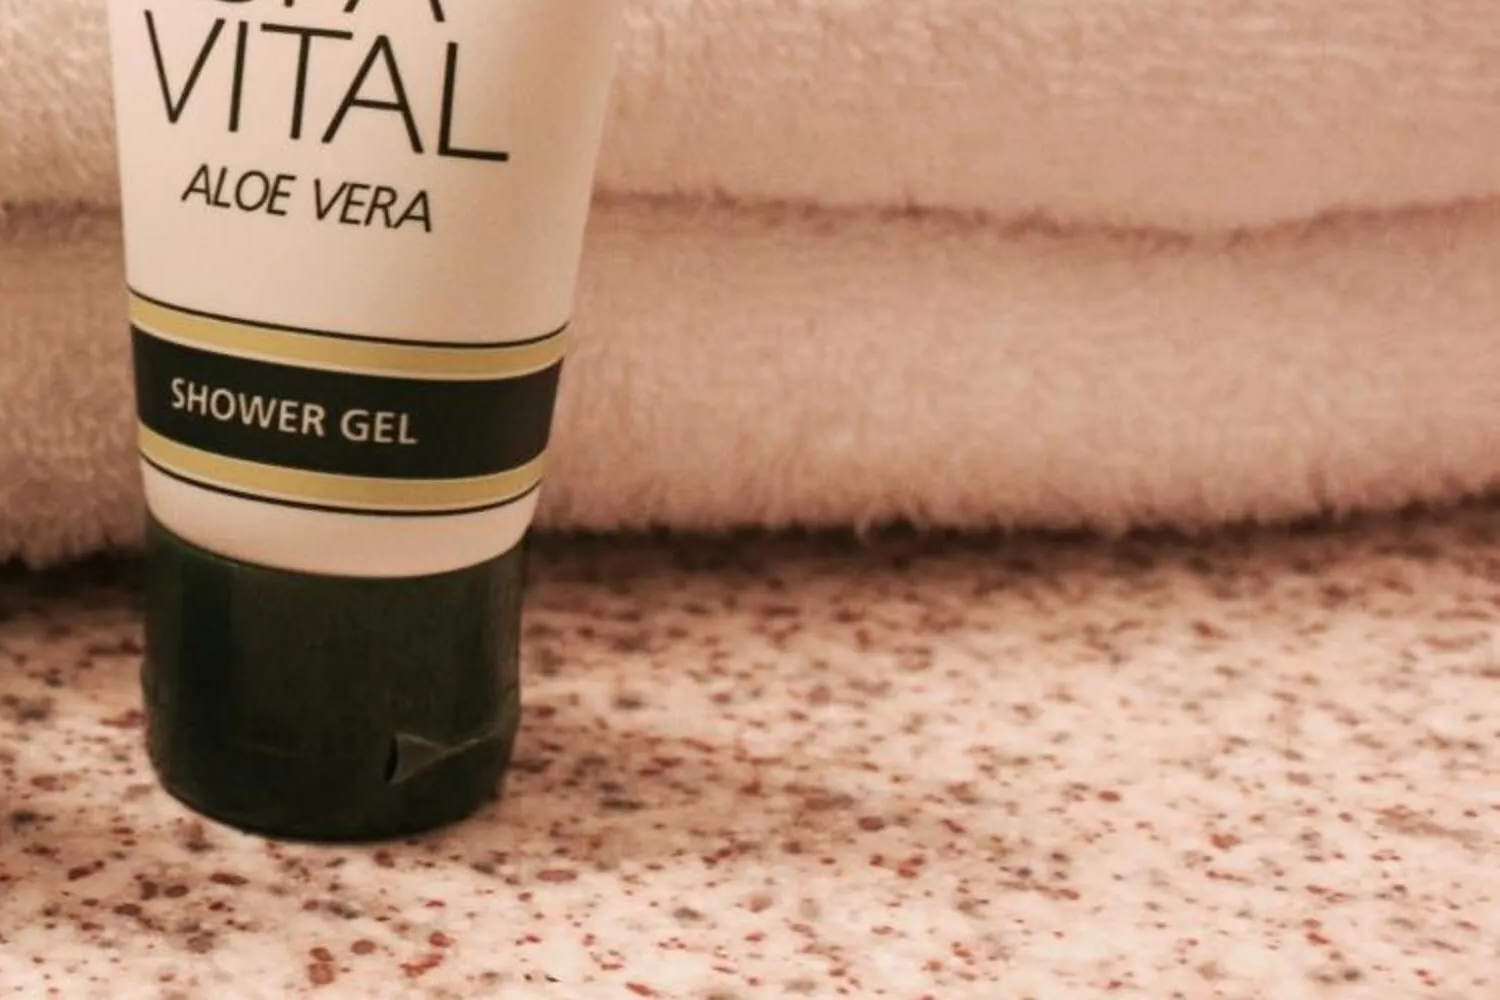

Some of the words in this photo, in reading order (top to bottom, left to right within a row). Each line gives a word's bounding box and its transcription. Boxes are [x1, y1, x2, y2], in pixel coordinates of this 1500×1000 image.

[143, 9, 512, 164] VITAL
[180, 162, 298, 217] ALOE
[313, 177, 433, 234] VERA
[169, 376, 328, 438] SHOWER
[340, 408, 419, 446] GEL
